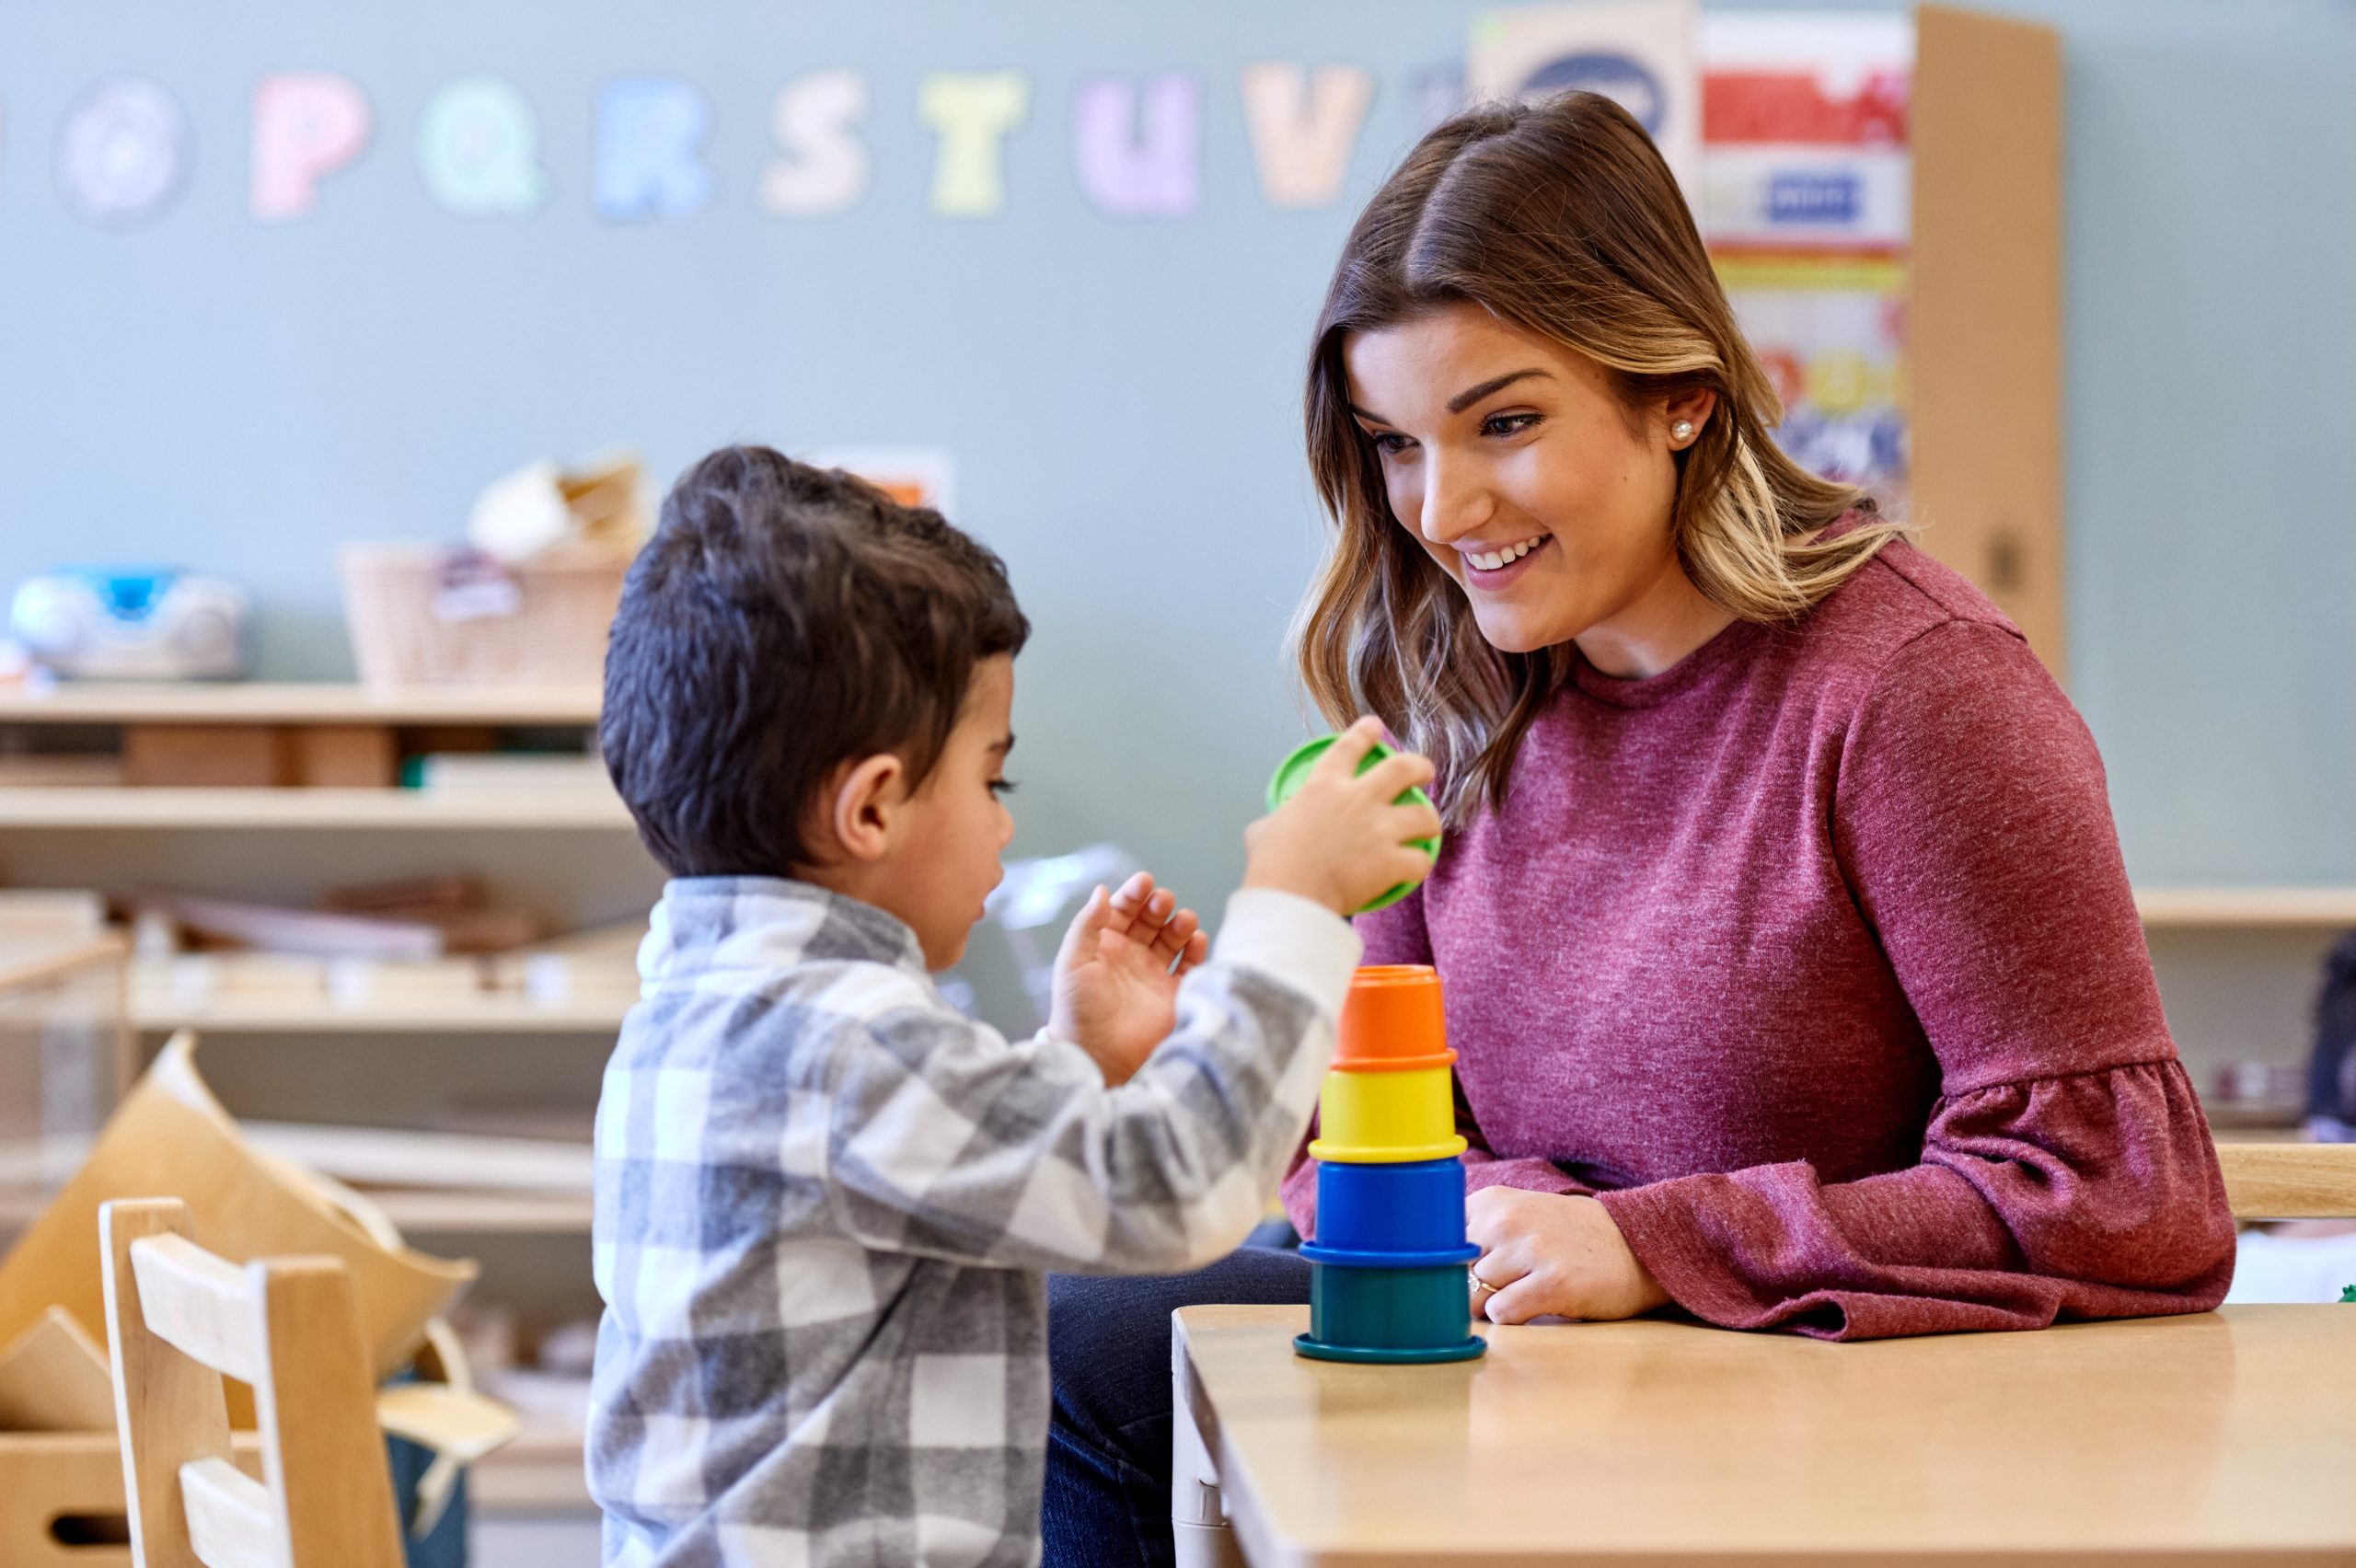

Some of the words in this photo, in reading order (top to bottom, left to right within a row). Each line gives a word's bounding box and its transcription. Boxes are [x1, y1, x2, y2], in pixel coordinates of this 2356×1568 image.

[59, 74, 188, 226] O
[248, 68, 372, 223] P
[416, 74, 547, 217] Q
[595, 74, 714, 225] R
[760, 68, 869, 217] S
[922, 70, 1027, 217] T
[1073, 70, 1202, 219] U
[1239, 61, 1375, 210] V
